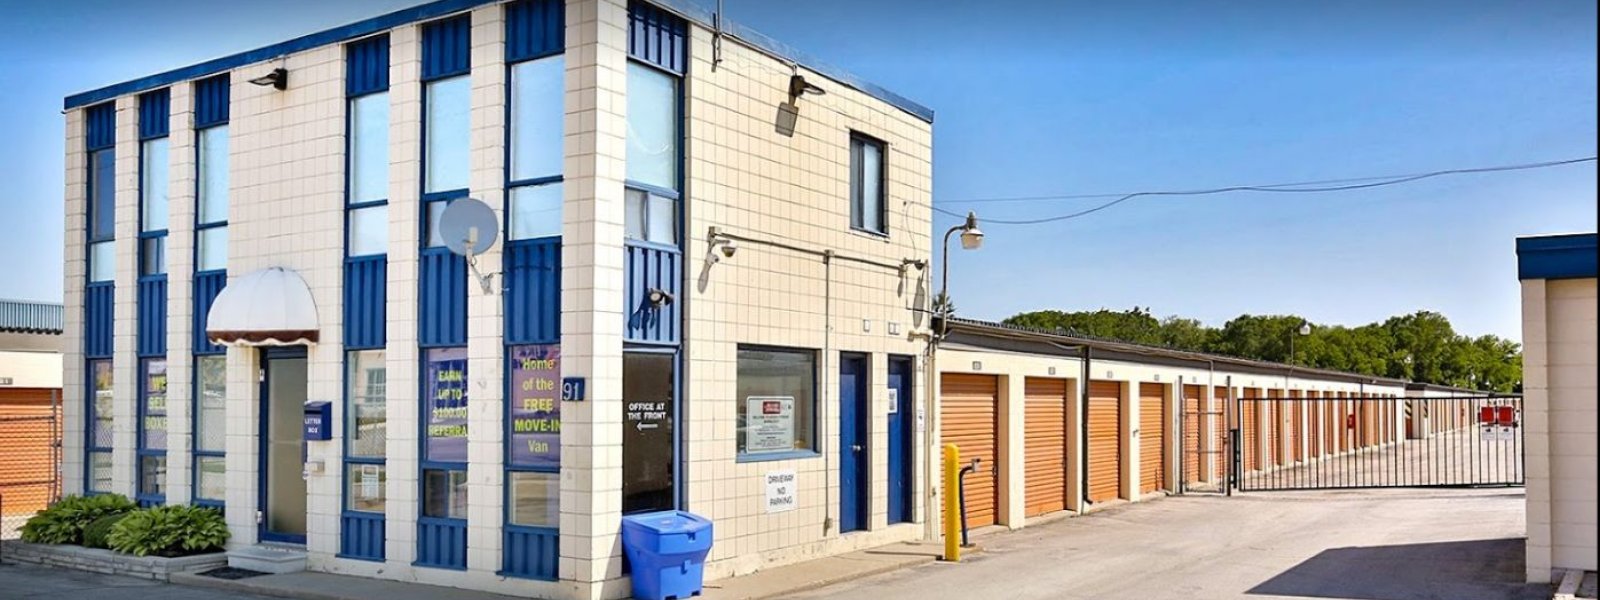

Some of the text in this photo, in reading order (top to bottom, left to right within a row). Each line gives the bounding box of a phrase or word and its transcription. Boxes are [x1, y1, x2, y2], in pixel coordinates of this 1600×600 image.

[523, 359, 555, 370] Home
[438, 370, 461, 382] EARN
[522, 378, 554, 391] of the
[438, 388, 462, 400] UP TO
[563, 382, 579, 401] 91
[524, 398, 554, 411] FREE
[628, 402, 665, 411] OFFICE AT
[627, 411, 667, 420] THE FRONT
[144, 415, 167, 431] BOXE
[514, 419, 561, 432] MOVE-IN
[428, 424, 468, 437] REFERRA
[527, 440, 549, 453] Van
[768, 474, 794, 484] DRIVEWAY
[776, 486, 786, 495] NO
[769, 496, 793, 506] PARKING
